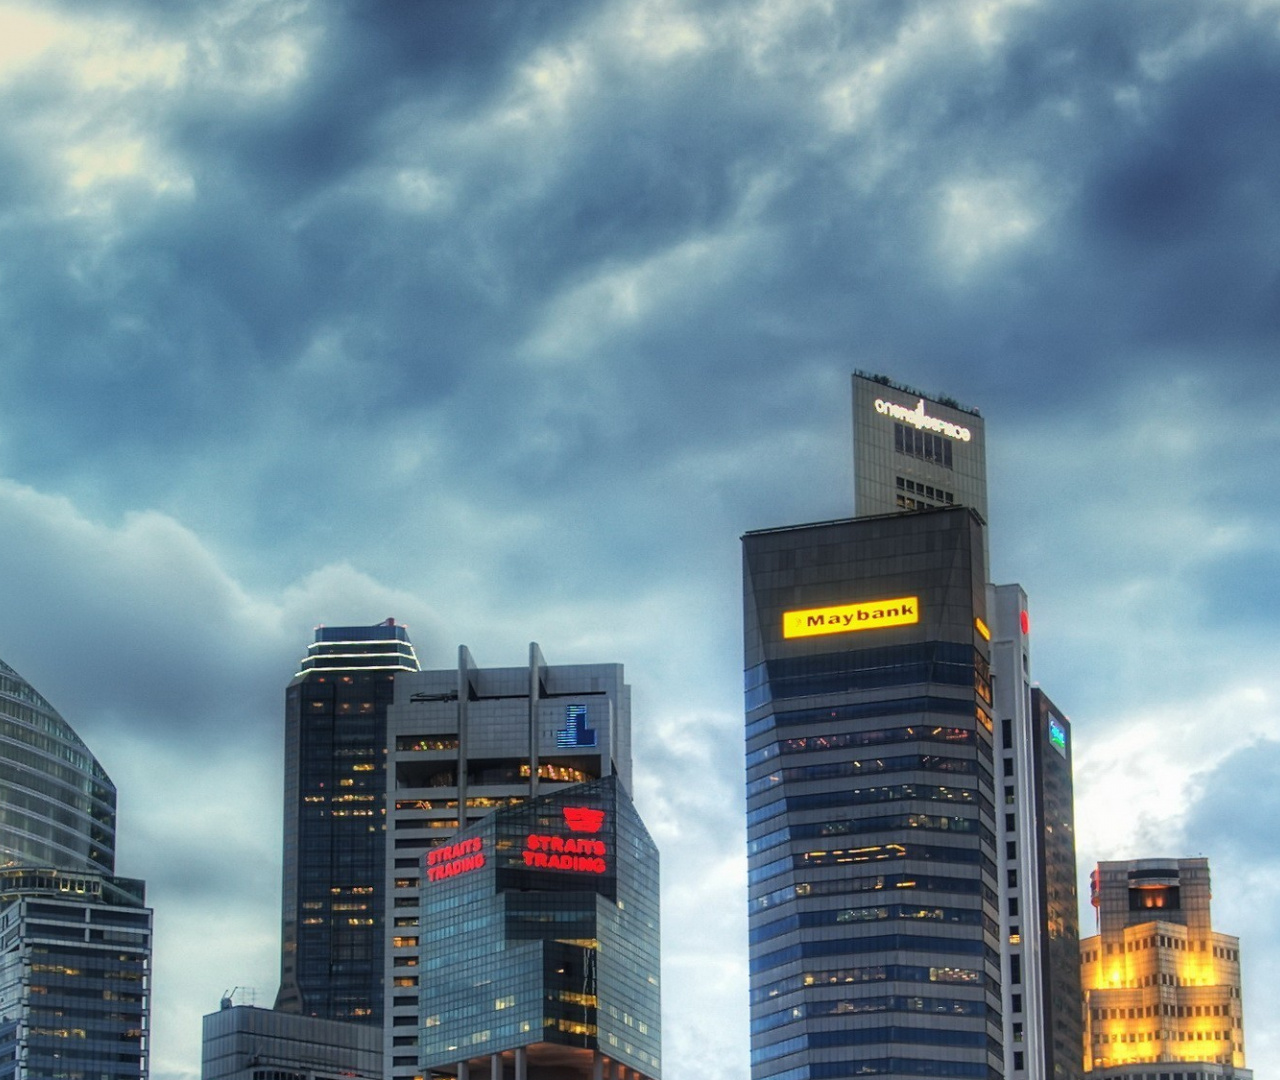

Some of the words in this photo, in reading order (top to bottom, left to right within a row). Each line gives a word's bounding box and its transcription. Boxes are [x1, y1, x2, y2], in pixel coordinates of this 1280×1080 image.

[806, 604, 914, 627] Maybank
[427, 837, 483, 866] STRAITS
[527, 834, 606, 856] STRAITS
[426, 852, 486, 882] TRADING
[522, 851, 606, 873] TRADING
